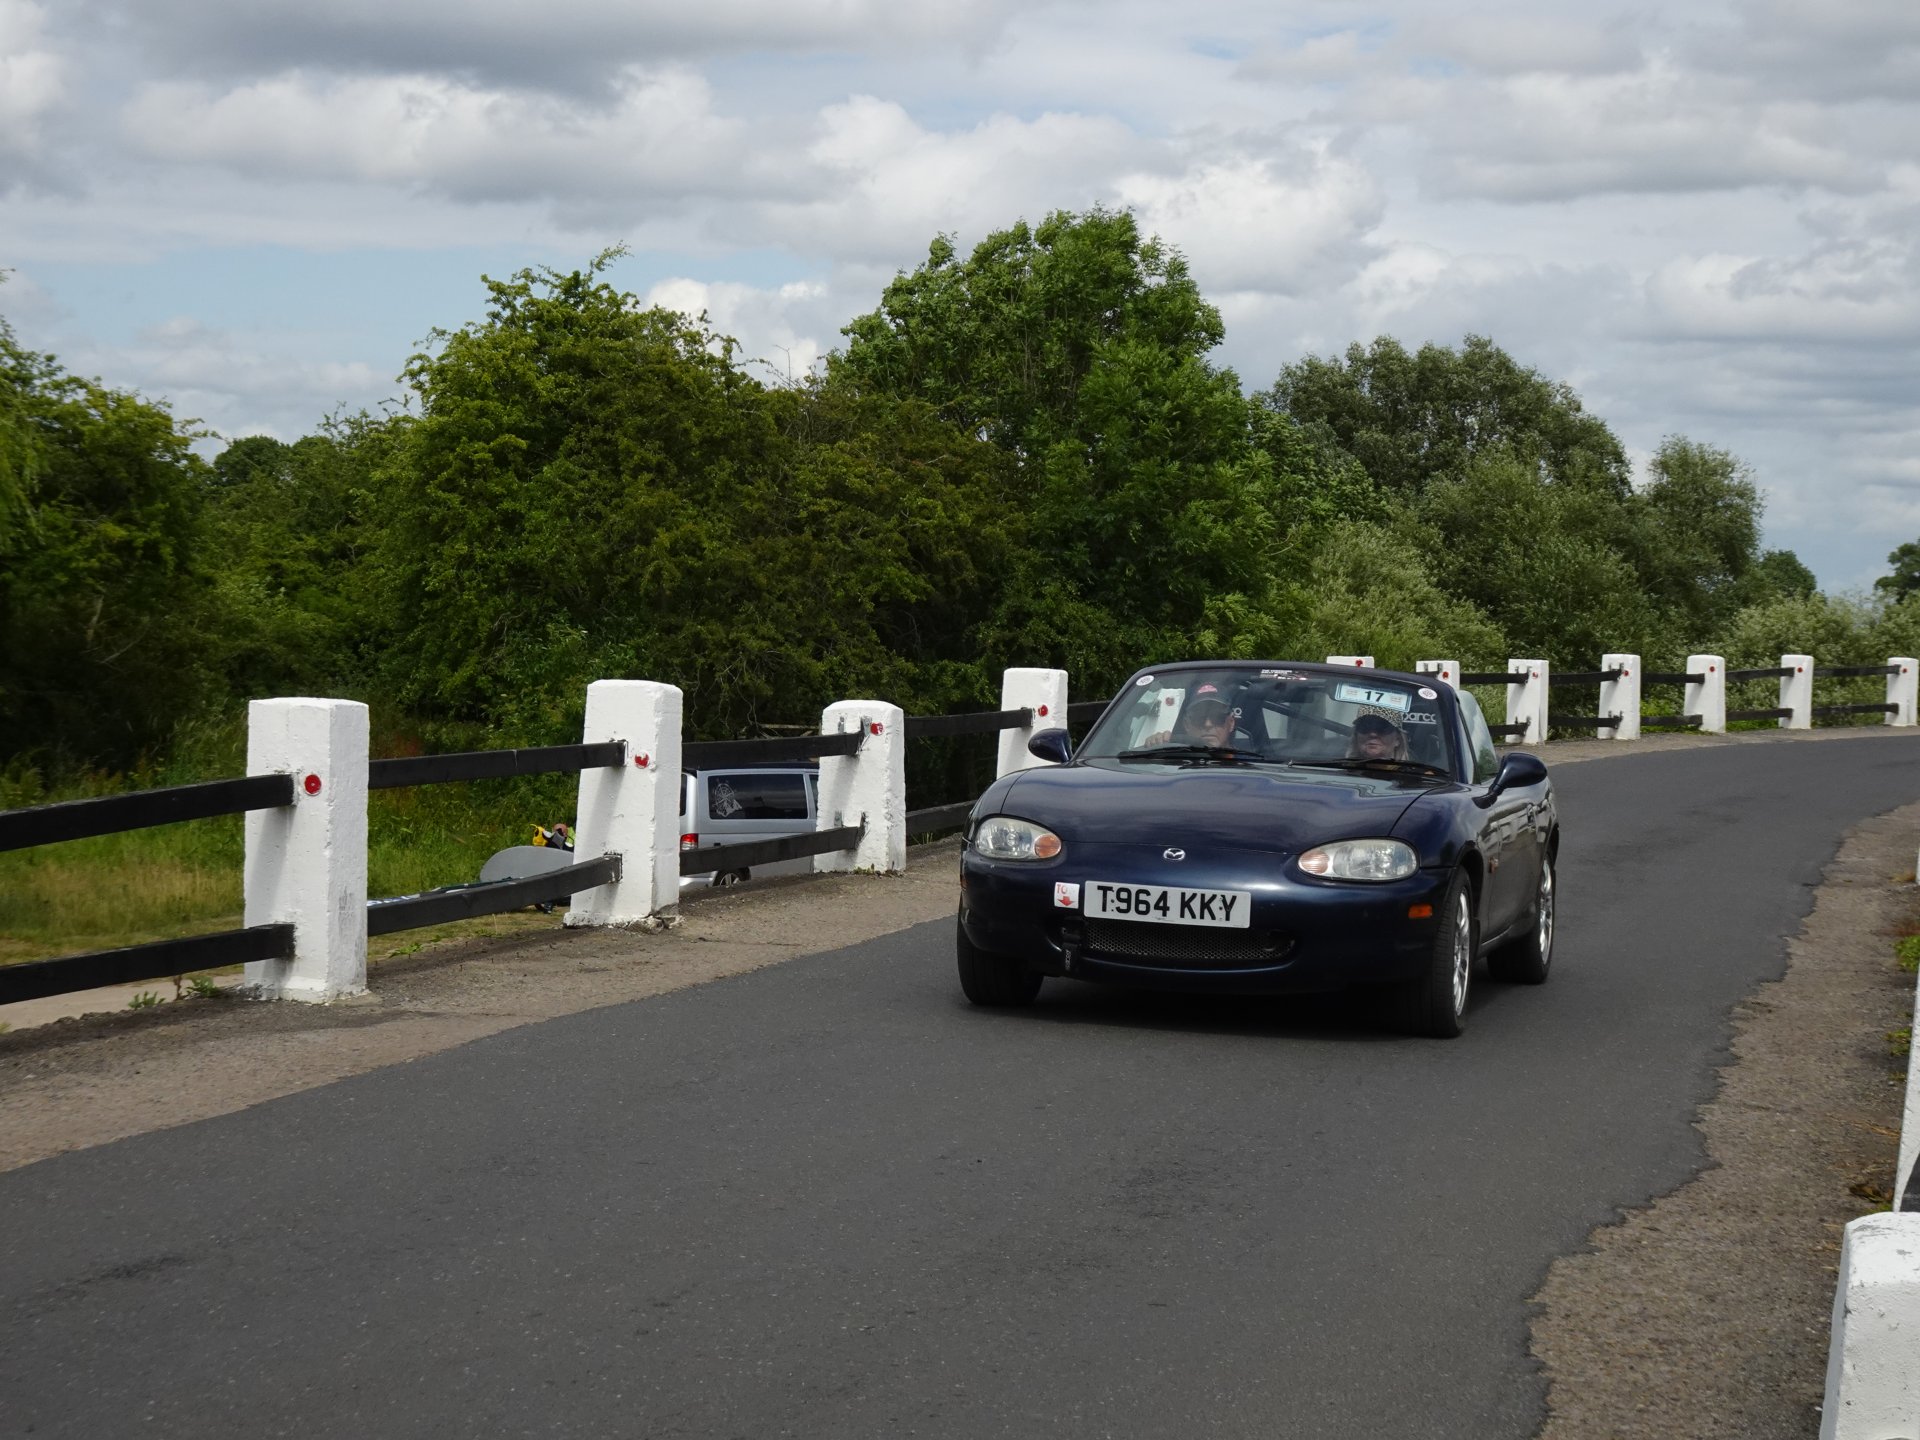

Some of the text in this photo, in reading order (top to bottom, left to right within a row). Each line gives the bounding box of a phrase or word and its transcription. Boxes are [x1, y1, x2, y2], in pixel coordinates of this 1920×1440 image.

[1364, 691, 1385, 703] 17
[1097, 885, 1237, 921] T964 KKY
